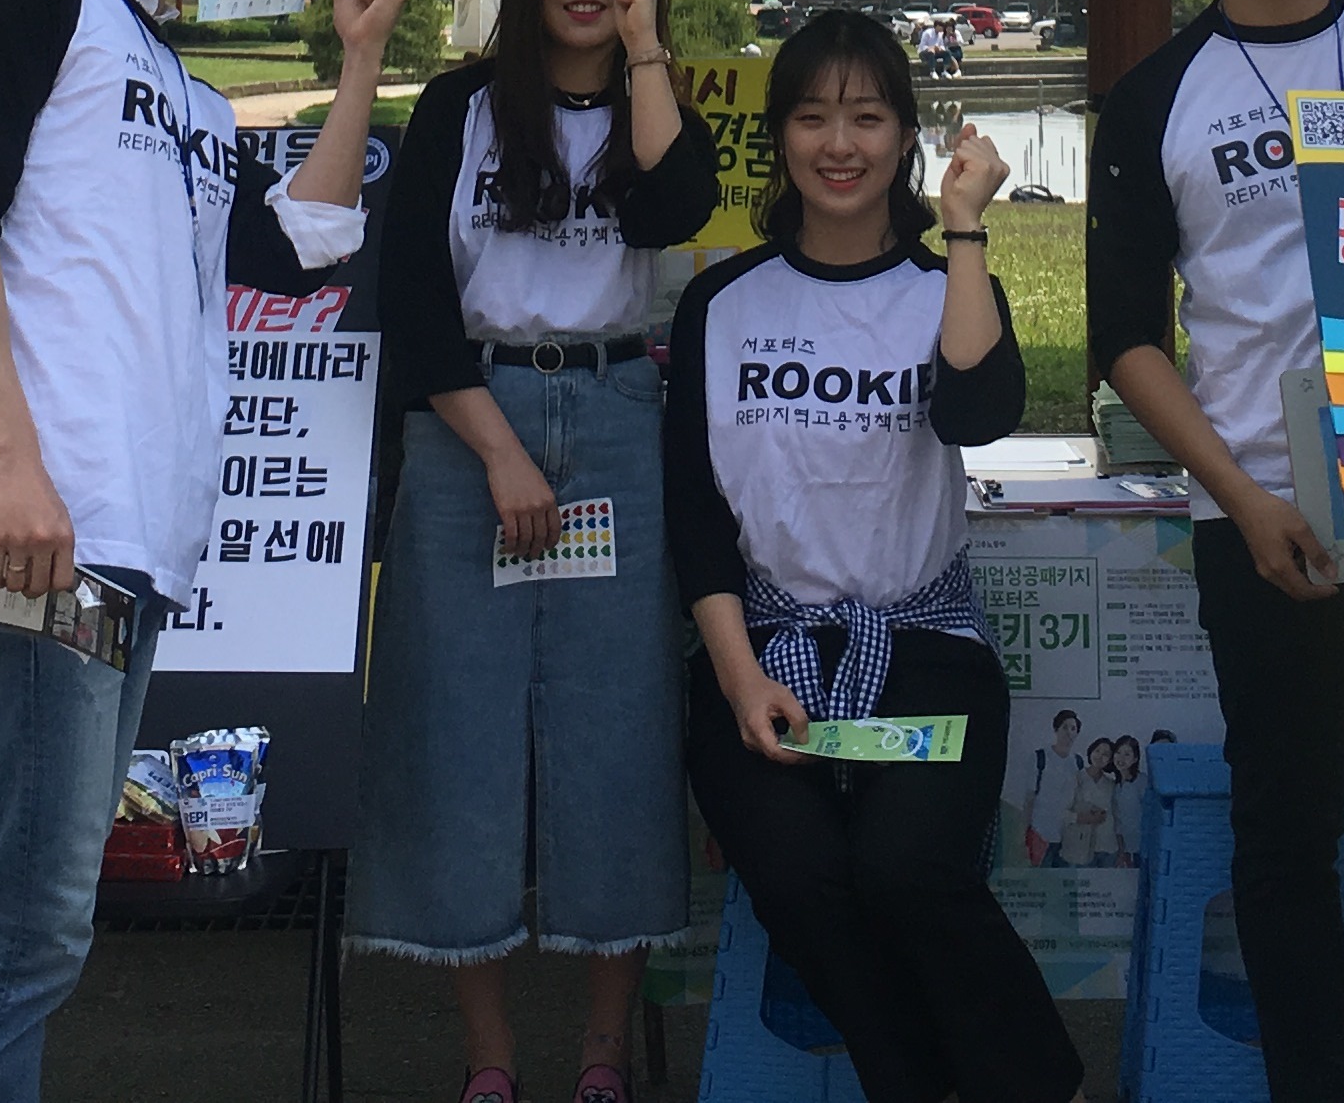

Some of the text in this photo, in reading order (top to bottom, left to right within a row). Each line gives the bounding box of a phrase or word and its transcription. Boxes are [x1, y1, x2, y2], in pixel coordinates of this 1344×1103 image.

[122, 78, 239, 186] ROKIE
[1207, 104, 1286, 136] 서포터즈
[742, 336, 816, 355] 서포터즈
[736, 406, 928, 432] REPI지역고용정책연구
[221, 455, 328, 497] 이르는
[972, 565, 1090, 587] 취업성공패키지
[1039, 613, 1089, 650] 3기
